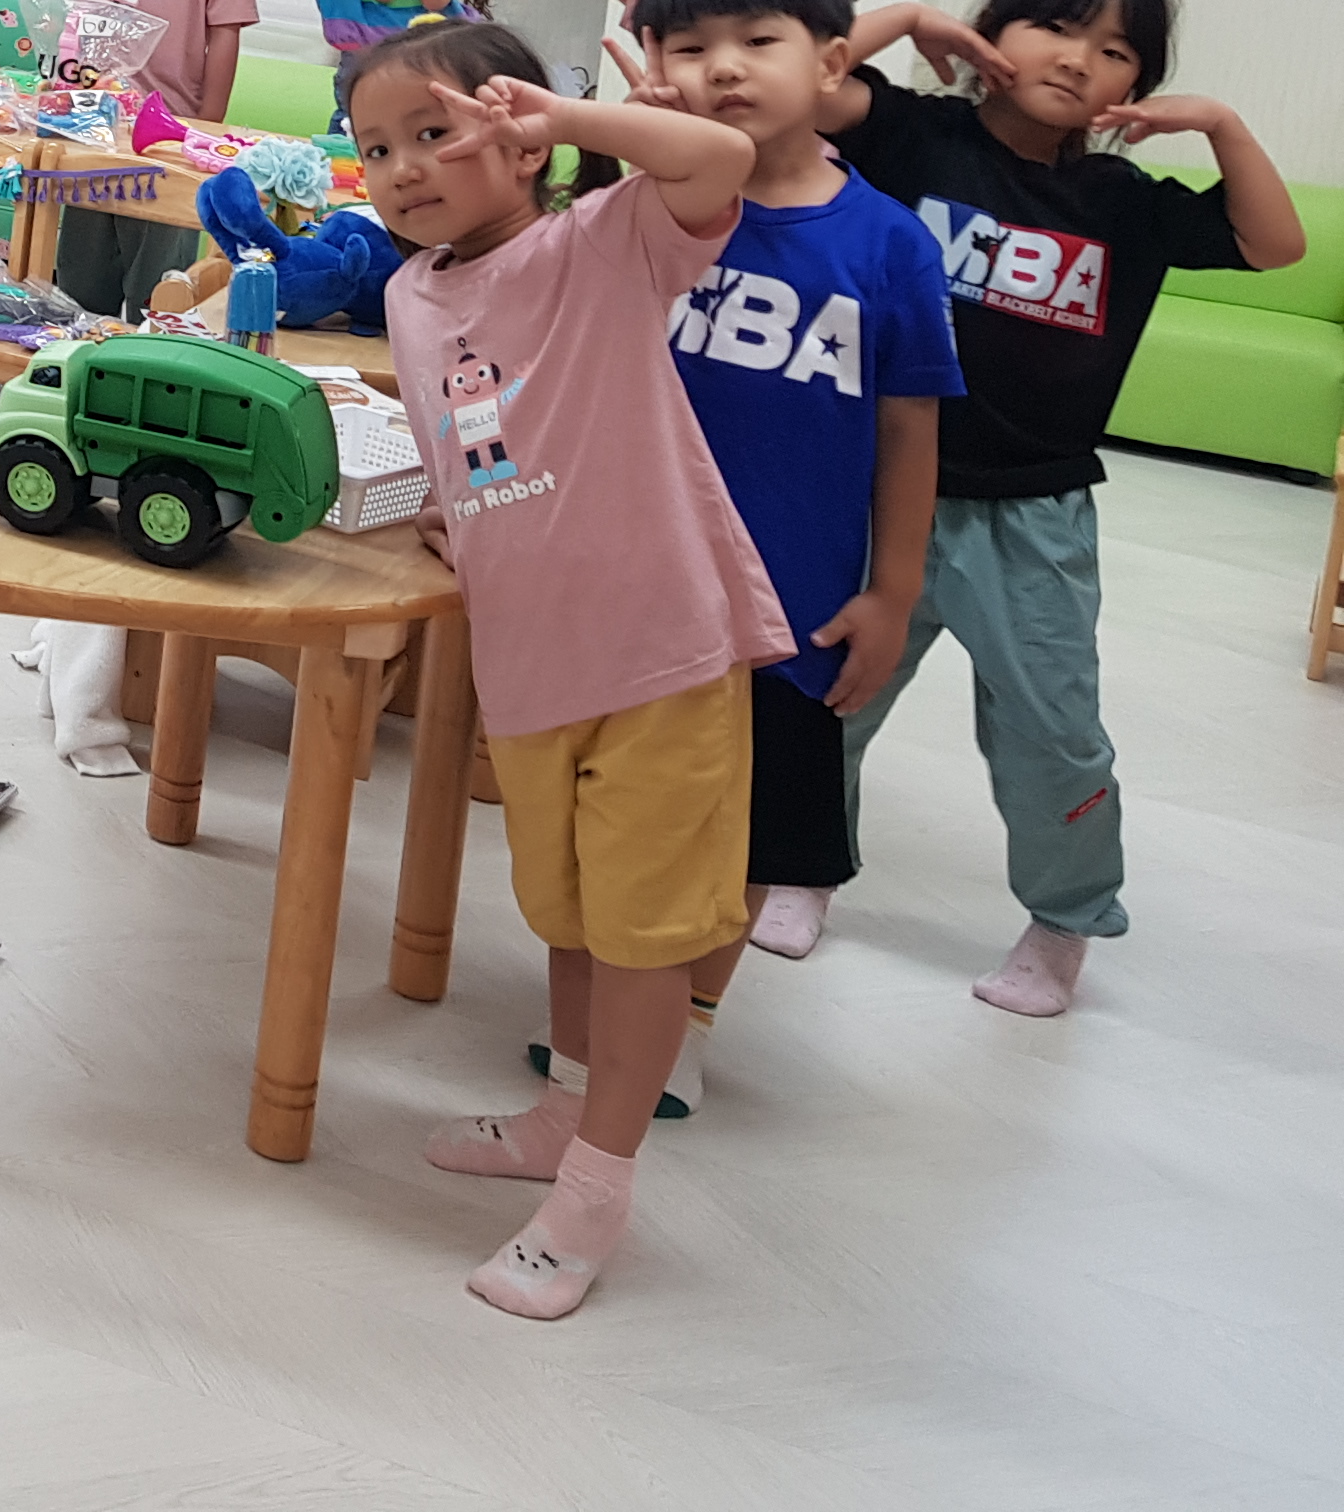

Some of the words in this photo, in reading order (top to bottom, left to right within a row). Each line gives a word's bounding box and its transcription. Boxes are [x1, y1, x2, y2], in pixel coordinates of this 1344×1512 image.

[459, 410, 497, 432] HELLO
[453, 496, 481, 522] I'm
[482, 469, 556, 510] Robot
